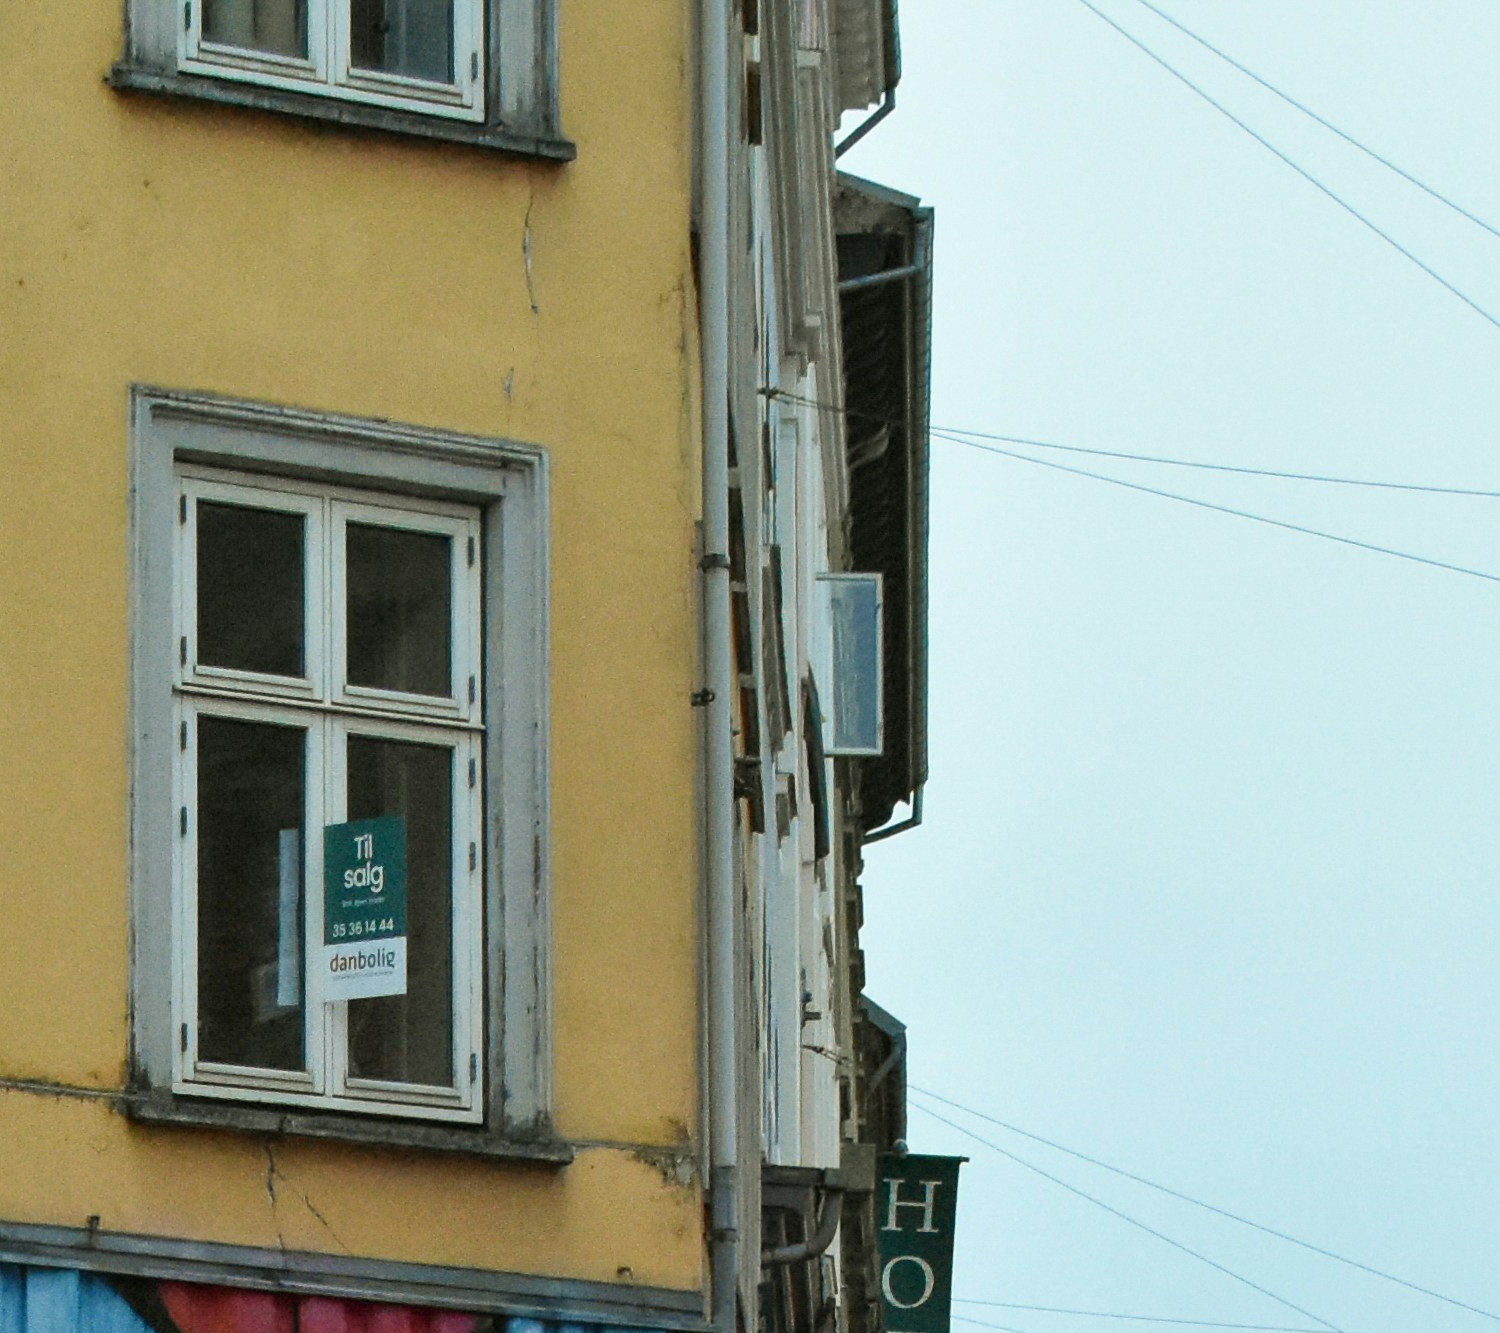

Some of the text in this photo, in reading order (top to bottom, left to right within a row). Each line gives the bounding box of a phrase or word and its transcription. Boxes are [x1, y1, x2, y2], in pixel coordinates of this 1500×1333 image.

[354, 833, 373, 860] Til
[344, 860, 384, 893] salg
[365, 920, 377, 933] 14
[379, 918, 394, 932] 44
[329, 948, 396, 973] danbolig
